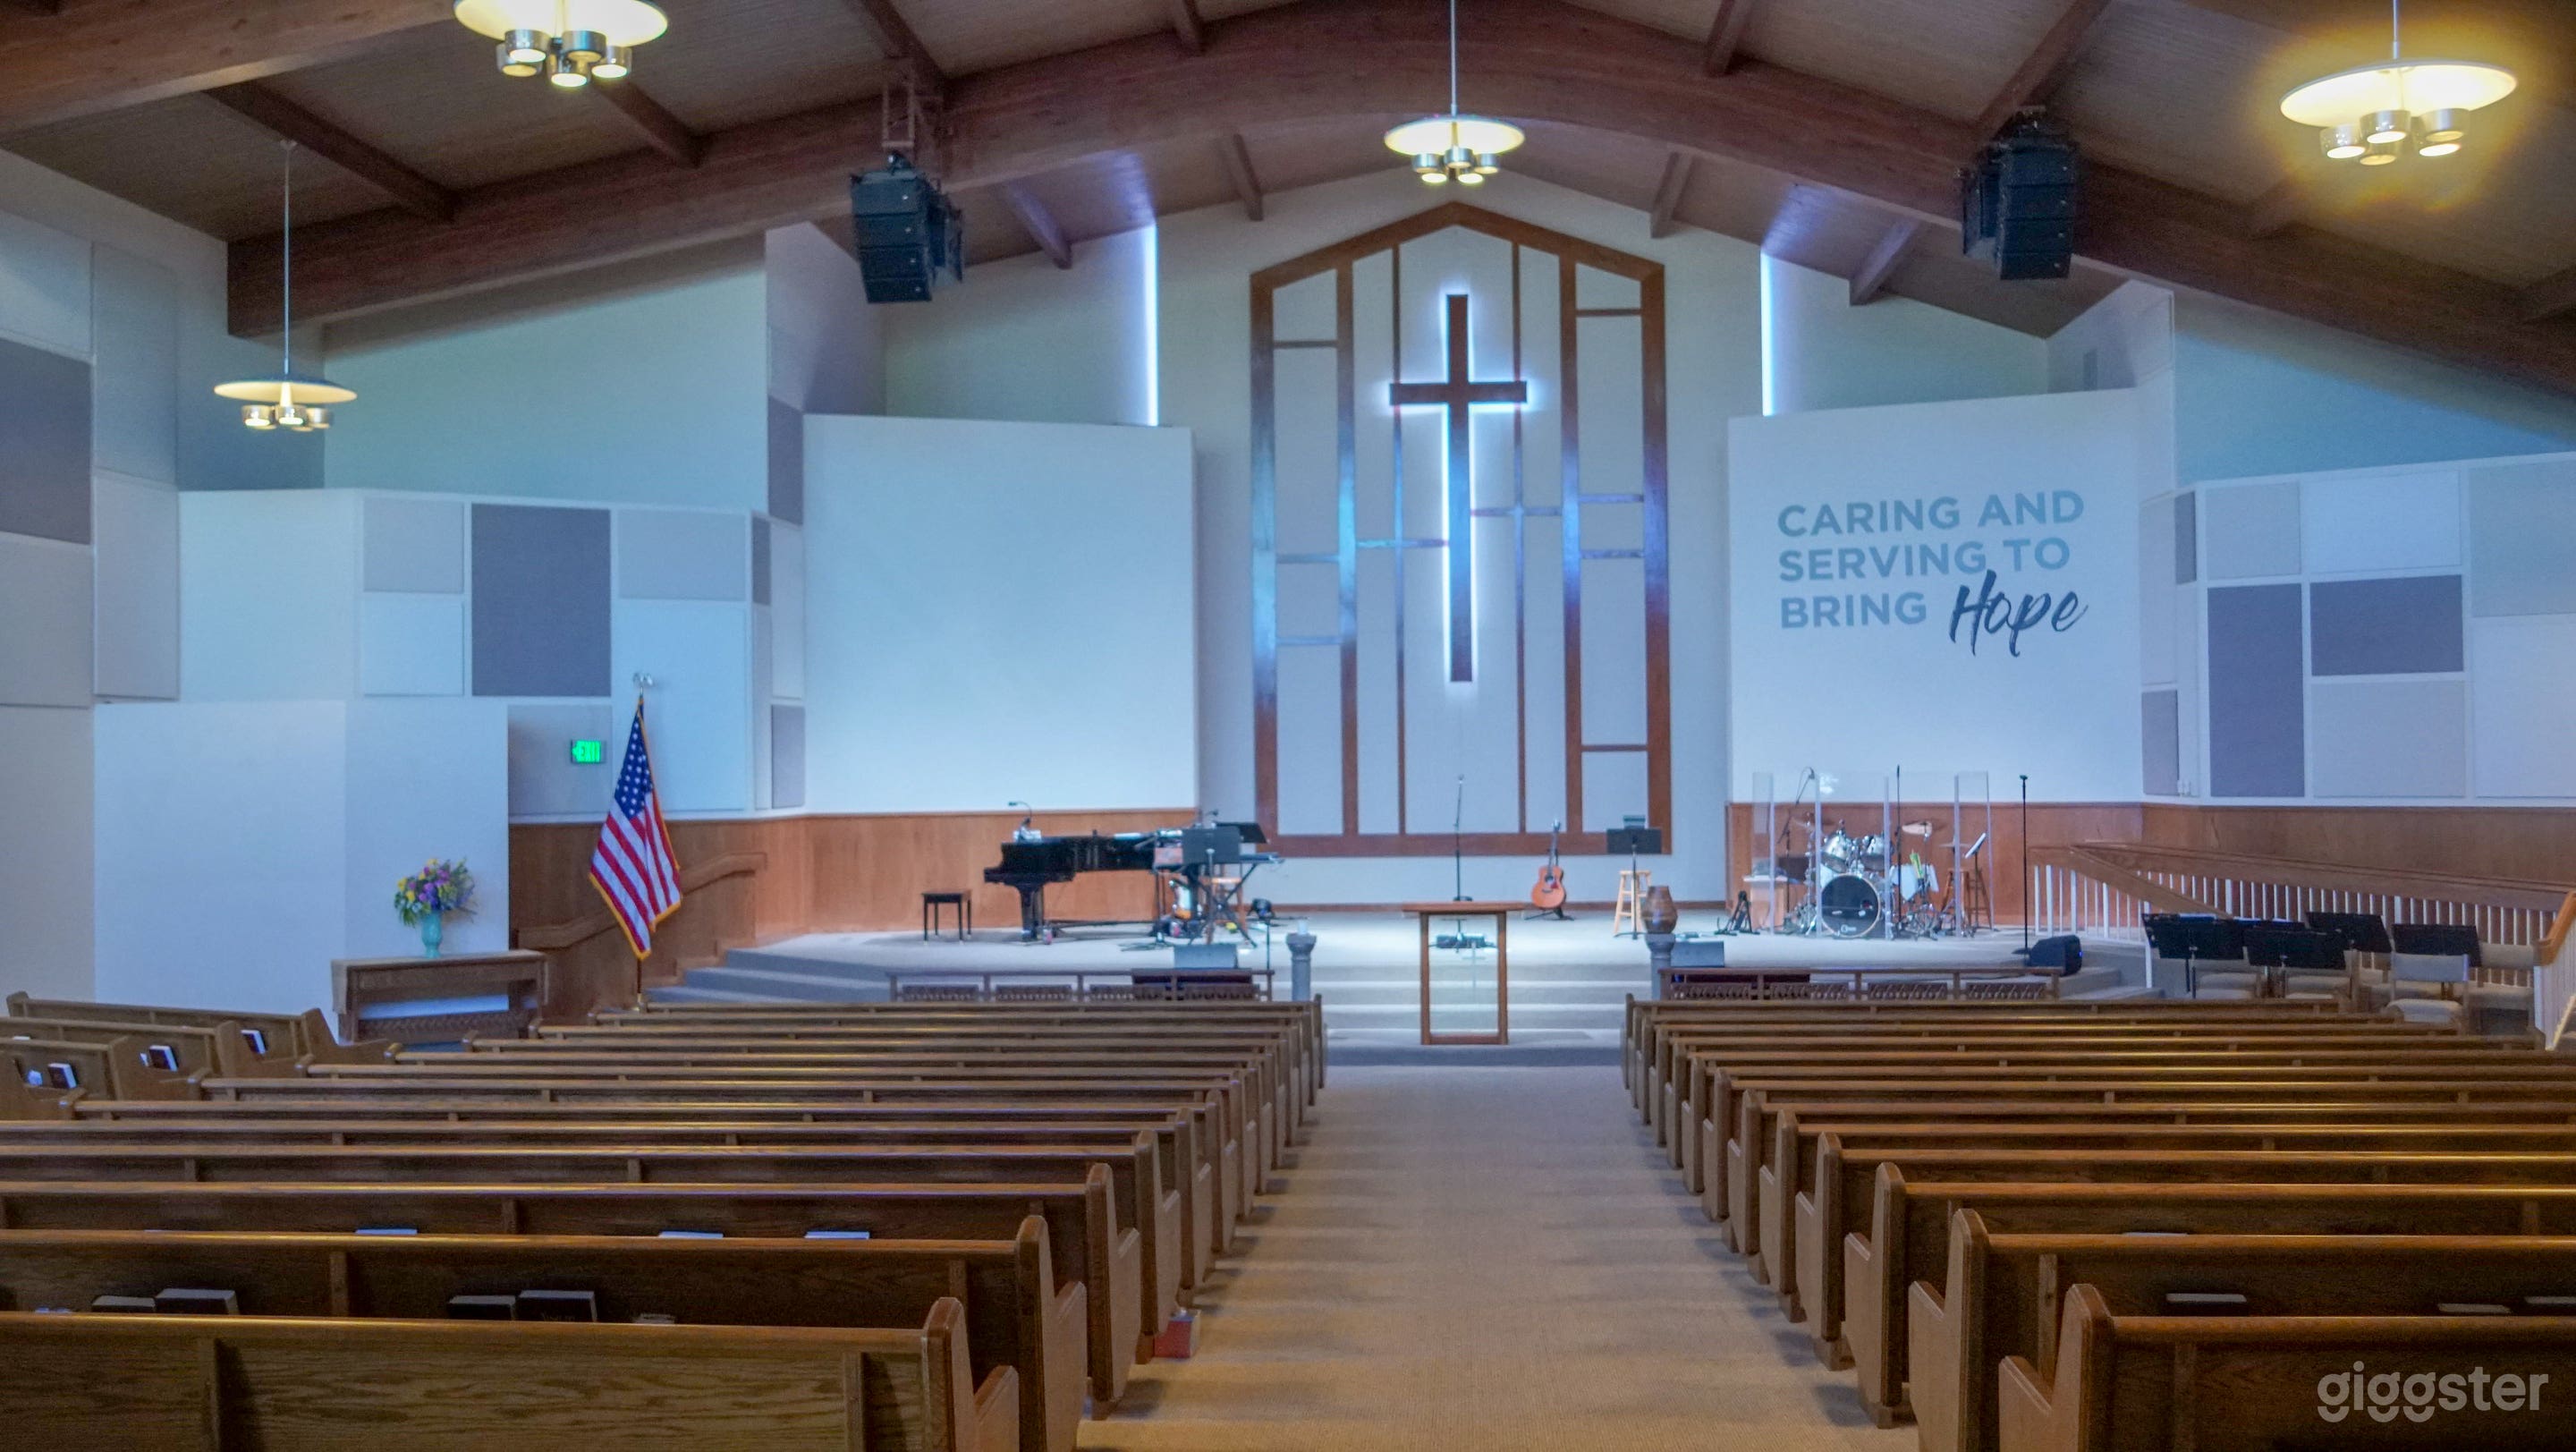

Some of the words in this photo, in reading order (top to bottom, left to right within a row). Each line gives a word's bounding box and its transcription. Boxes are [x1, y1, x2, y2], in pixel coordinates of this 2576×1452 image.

[1777, 497, 1961, 538] CARING
[1978, 490, 2085, 527] AND
[1778, 541, 1987, 582] SERVING
[2003, 537, 2071, 573] TO
[1780, 591, 1928, 629] BRING
[1949, 569, 2089, 658] Hope
